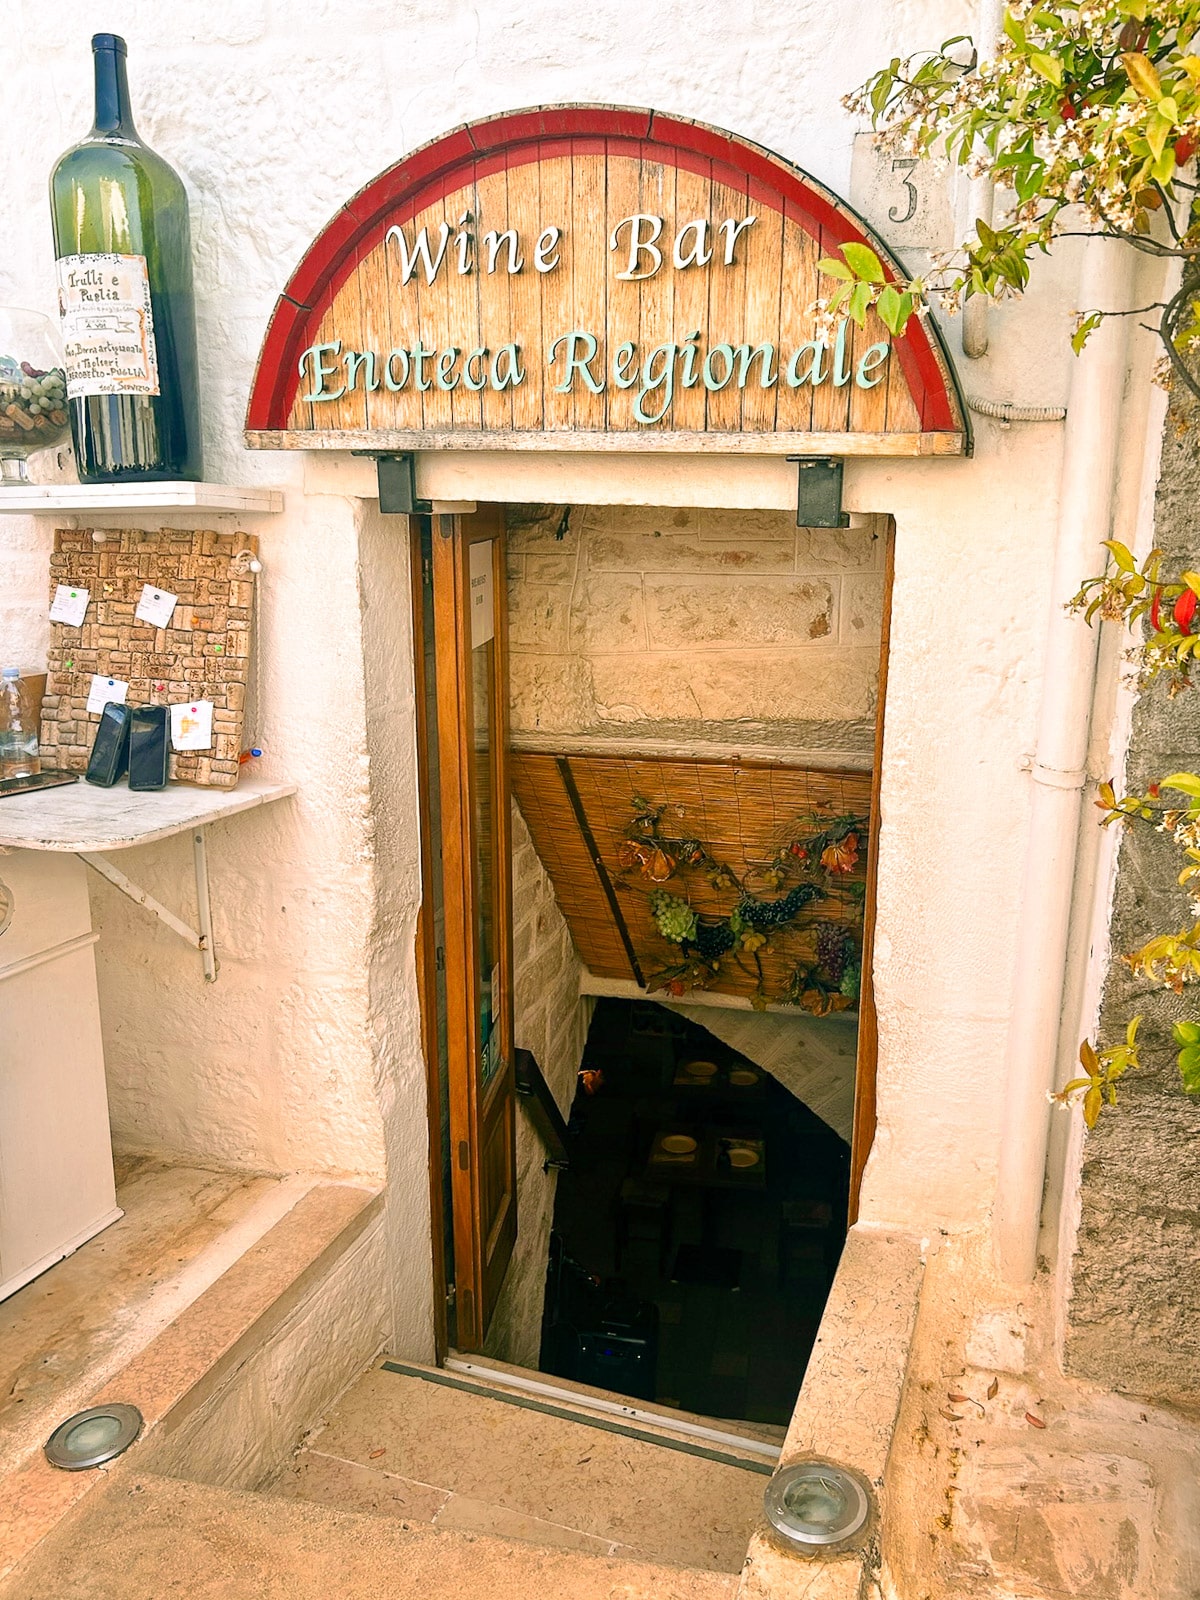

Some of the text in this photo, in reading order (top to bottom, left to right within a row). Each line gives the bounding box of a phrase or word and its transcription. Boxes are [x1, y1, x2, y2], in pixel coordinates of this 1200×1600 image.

[888, 158, 919, 223] 3
[68, 269, 120, 288] Trulli e
[385, 210, 757, 287] Wine Bar
[79, 288, 120, 303] Puglia
[298, 318, 891, 425] Enoteca Regionale
